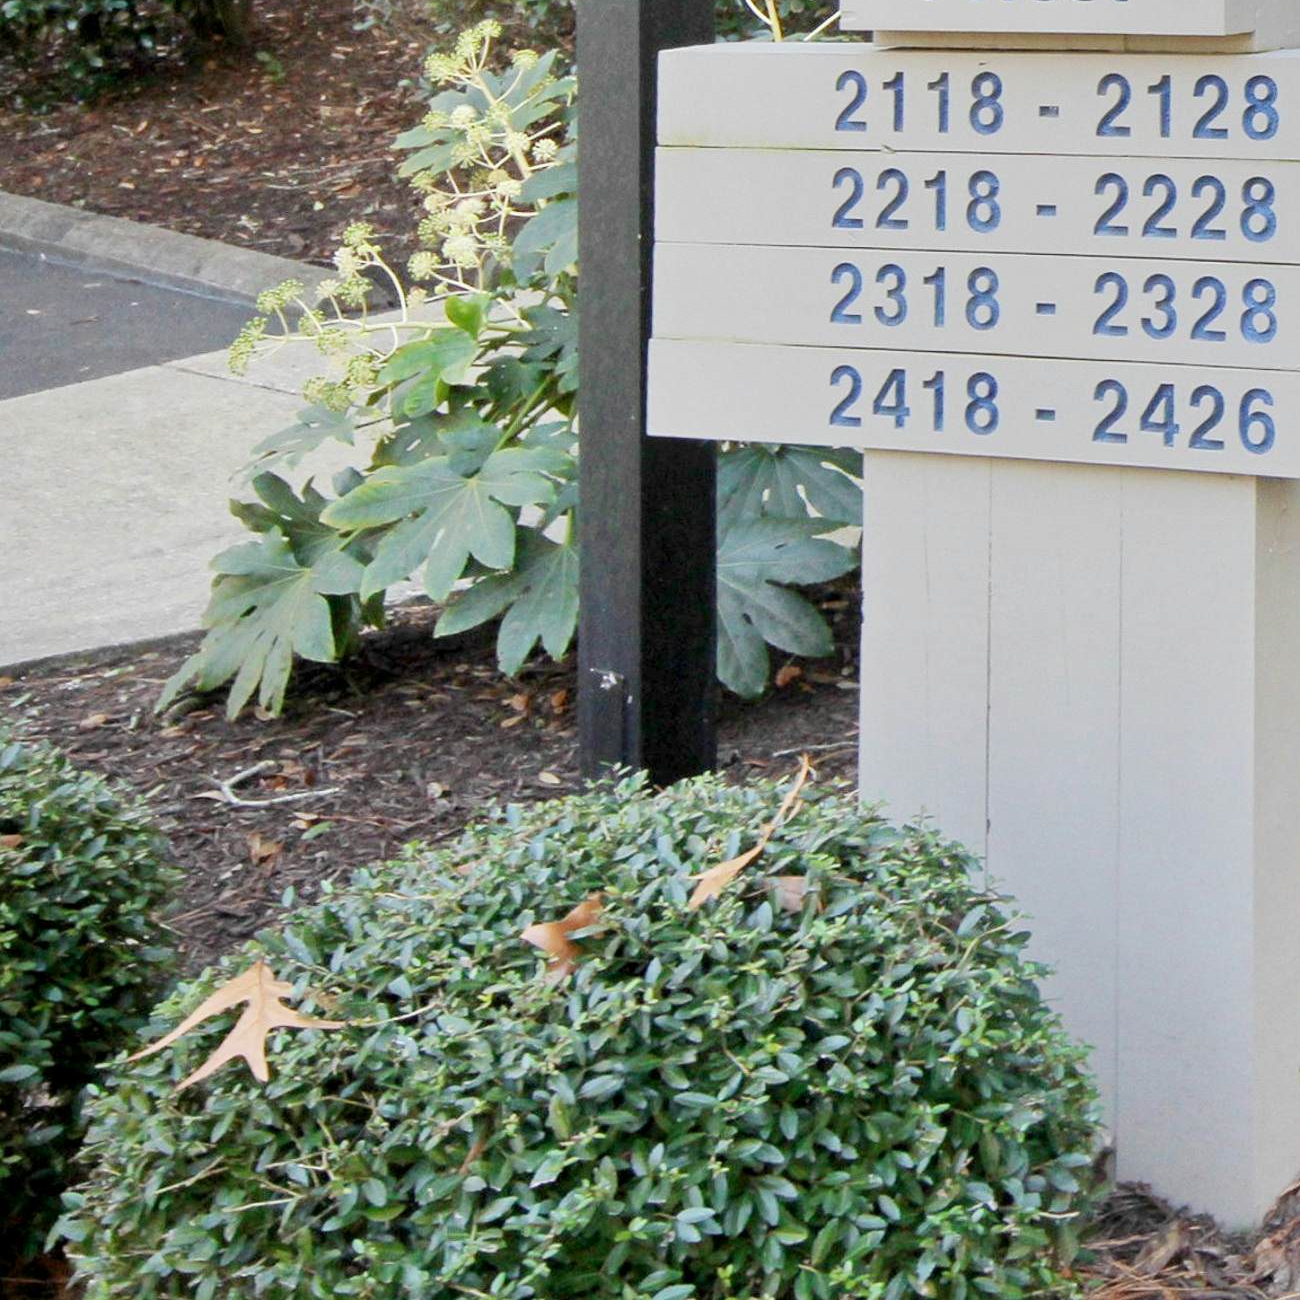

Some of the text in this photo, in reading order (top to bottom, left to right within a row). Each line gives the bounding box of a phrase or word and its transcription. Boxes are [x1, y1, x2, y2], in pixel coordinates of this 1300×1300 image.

[835, 70, 1279, 140] 2118 - 2128
[832, 167, 1276, 242] 2218 - 2228
[830, 263, 1278, 344] 2318 - 2328
[830, 365, 1275, 454] 2418 - 2426
